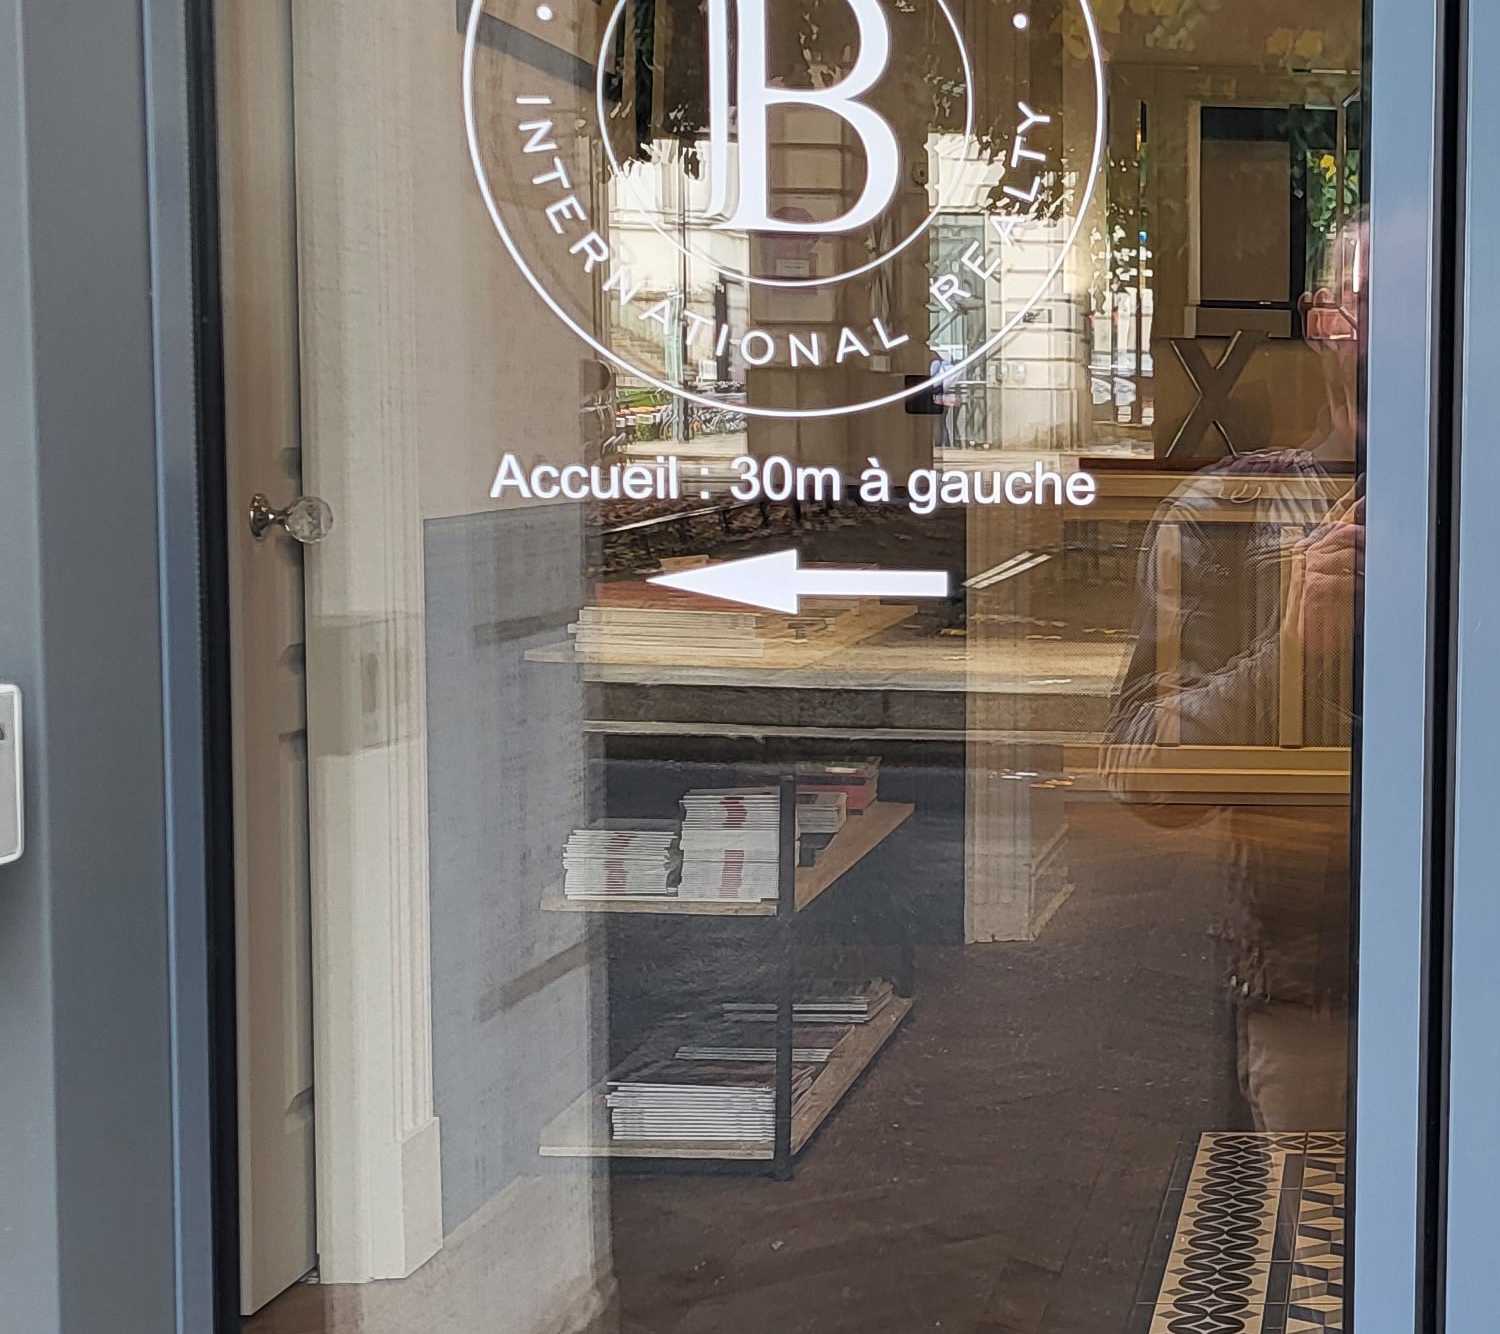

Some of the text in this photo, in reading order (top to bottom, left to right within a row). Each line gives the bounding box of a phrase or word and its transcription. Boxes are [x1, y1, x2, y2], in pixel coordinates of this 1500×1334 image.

[515, 94, 1050, 368] INTERNATIONAL REALTY
[489, 454, 681, 500] Accueil
[730, 455, 841, 501] 30m
[860, 457, 890, 502] à
[907, 461, 1097, 515] gauche
